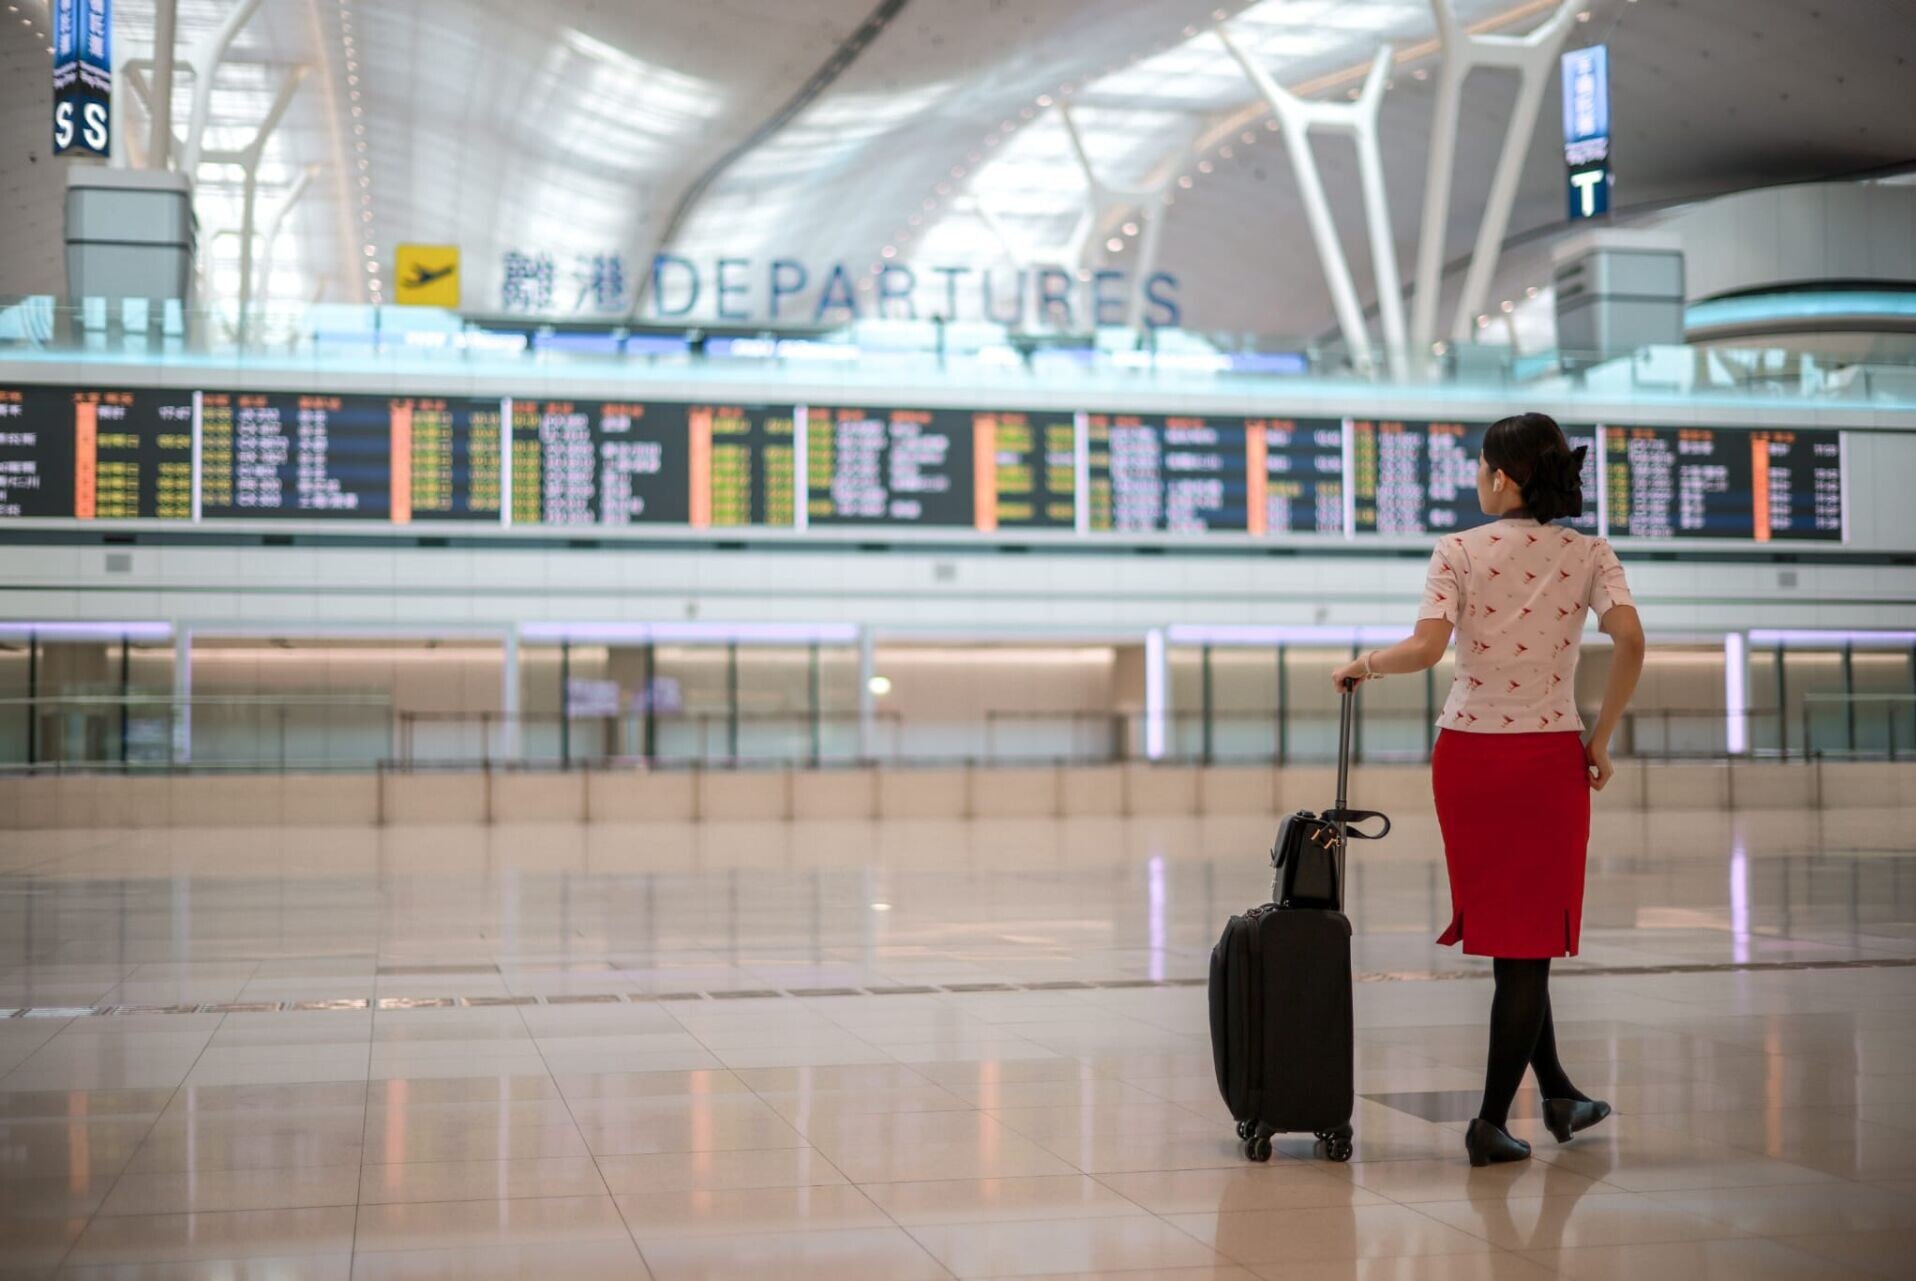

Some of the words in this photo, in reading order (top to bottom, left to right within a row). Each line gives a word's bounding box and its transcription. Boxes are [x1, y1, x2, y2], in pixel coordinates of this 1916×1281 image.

[55, 101, 74, 148] S
[83, 102, 107, 150] S
[1571, 169, 1604, 217] T
[652, 253, 1182, 327] DEPARTURES
